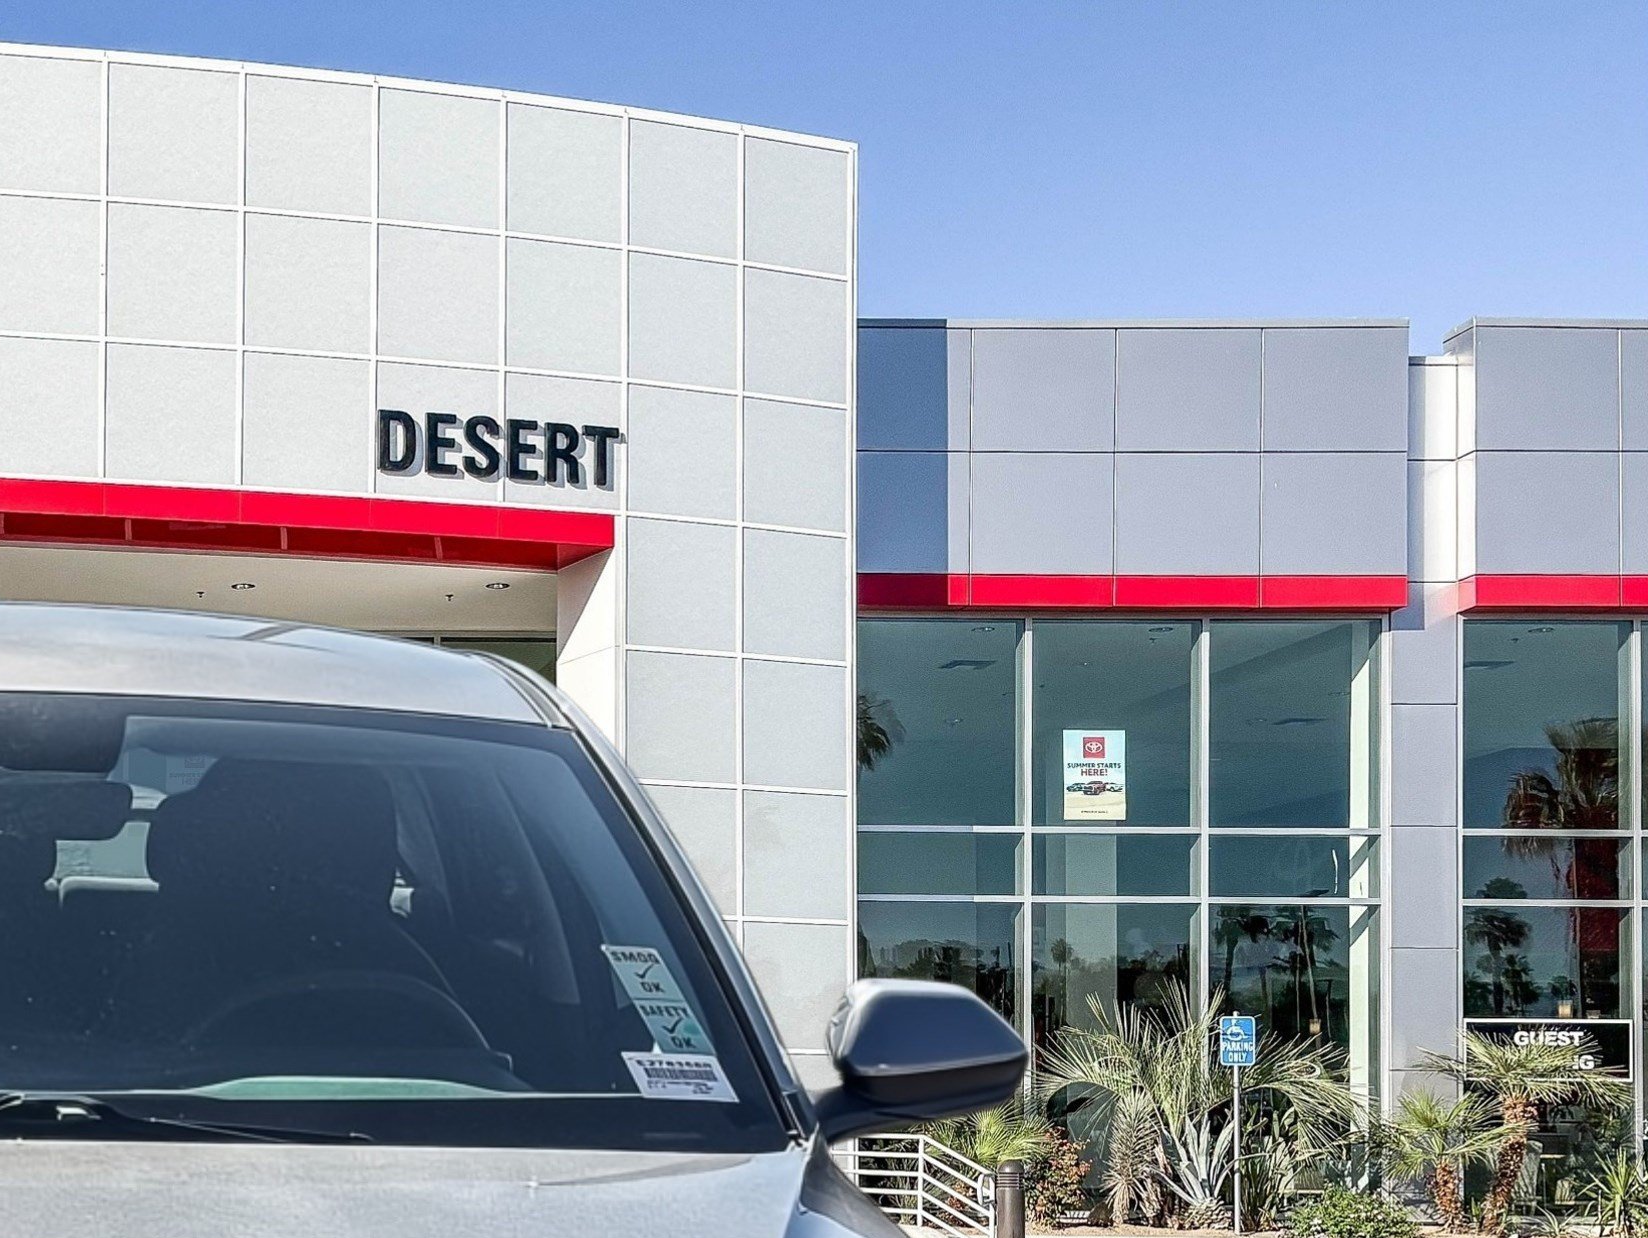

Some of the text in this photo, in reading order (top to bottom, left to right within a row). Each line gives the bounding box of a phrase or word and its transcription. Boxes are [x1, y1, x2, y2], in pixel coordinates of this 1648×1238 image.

[377, 409, 620, 487] DESERT
[1080, 768, 1108, 776] HERE!
[640, 981, 665, 994] OK
[638, 1004, 690, 1018] SAFETY
[670, 1036, 698, 1049] OK
[1513, 1030, 1585, 1047] GUEST
[1222, 1041, 1254, 1052] PARKING
[1228, 1051, 1248, 1062] ONLY
